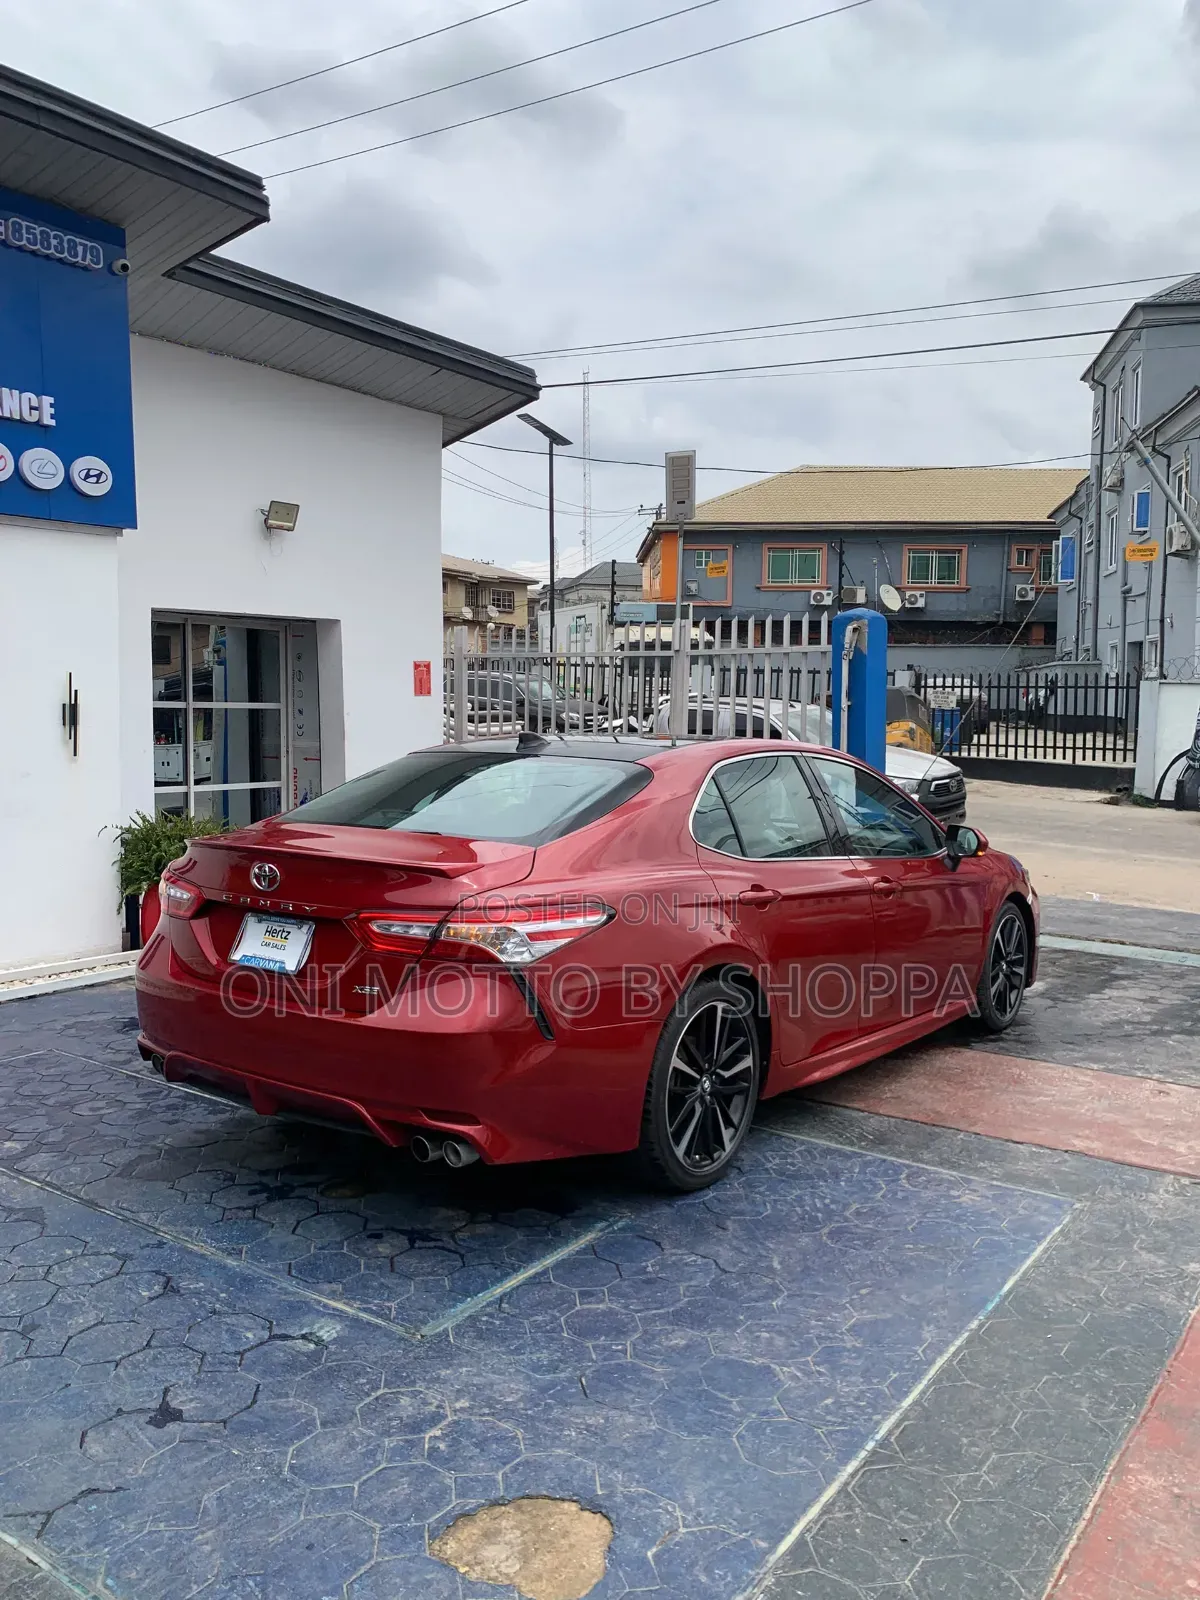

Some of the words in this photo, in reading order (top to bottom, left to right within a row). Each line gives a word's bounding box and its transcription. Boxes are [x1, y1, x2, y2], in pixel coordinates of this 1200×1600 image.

[8, 217, 104, 269] 8583879
[0, 387, 56, 427] NCE
[222, 894, 317, 912] CAMRY
[264, 925, 291, 940] Hertz
[271, 943, 286, 951] SALES
[245, 956, 280, 969] CARVANA
[352, 985, 380, 995] XSE
